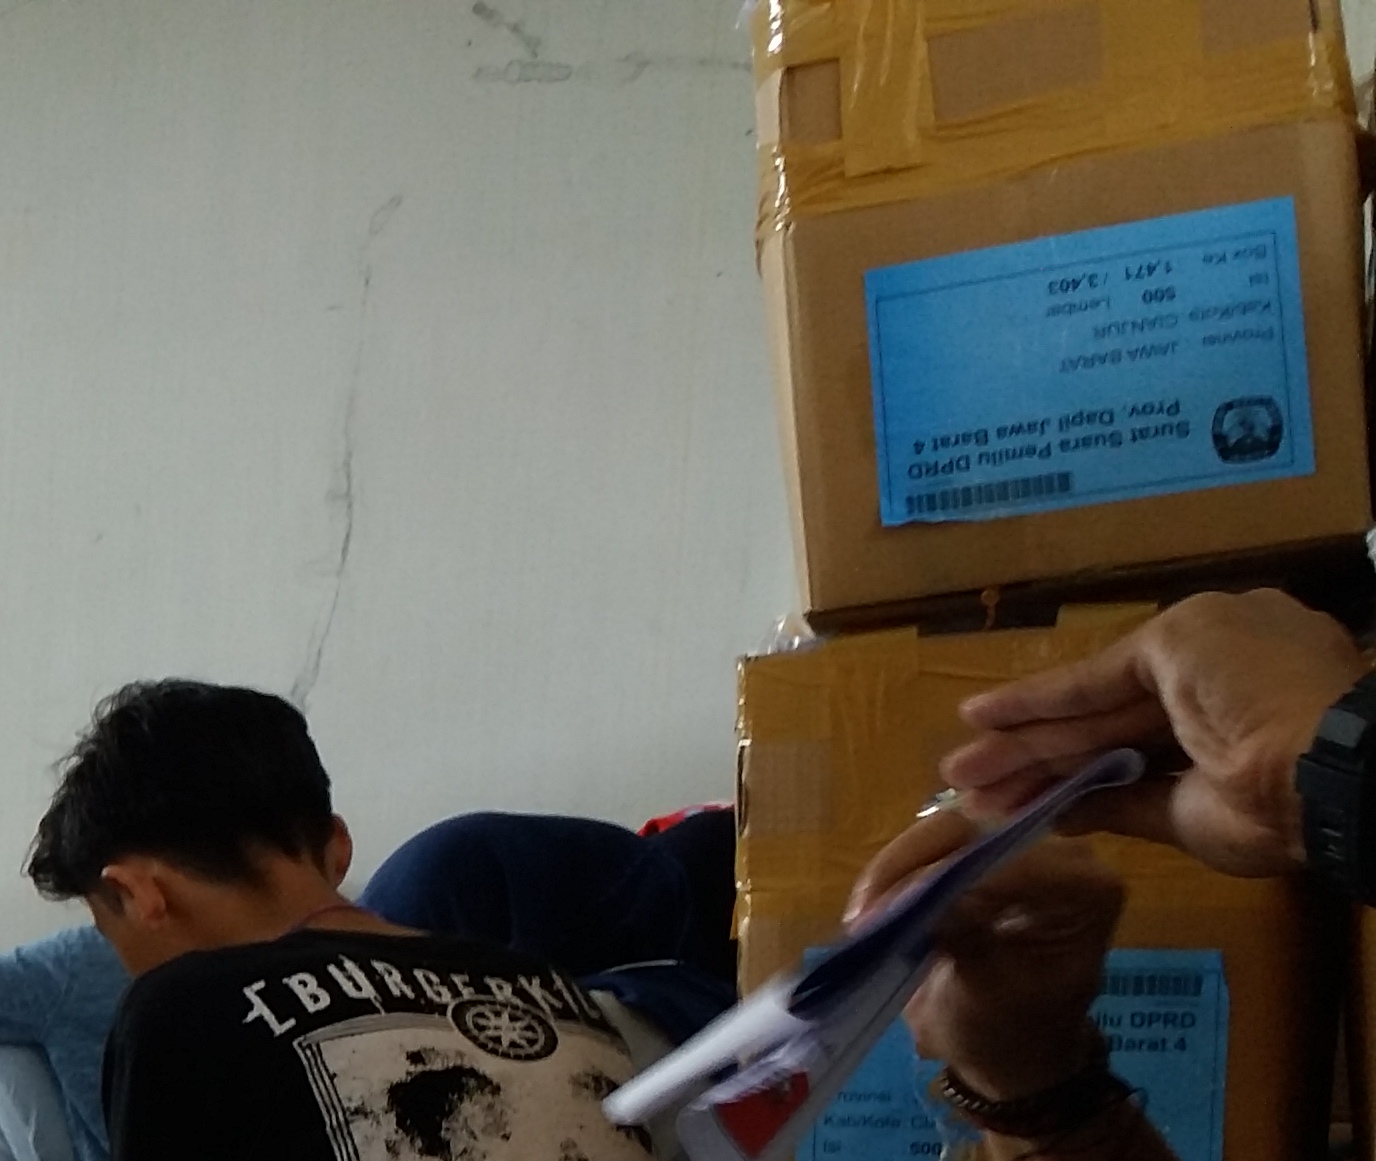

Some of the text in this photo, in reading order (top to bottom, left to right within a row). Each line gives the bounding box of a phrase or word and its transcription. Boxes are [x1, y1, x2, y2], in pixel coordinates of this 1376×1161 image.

[996, 418, 1050, 440] Jawa
[1058, 407, 1115, 433] Dapil
[1129, 420, 1191, 443] Surat
[913, 438, 926, 456] 4
[977, 441, 1053, 467] Pemilu
[907, 454, 972, 480] DPRD
[1131, 1010, 1196, 1029] DPRD
